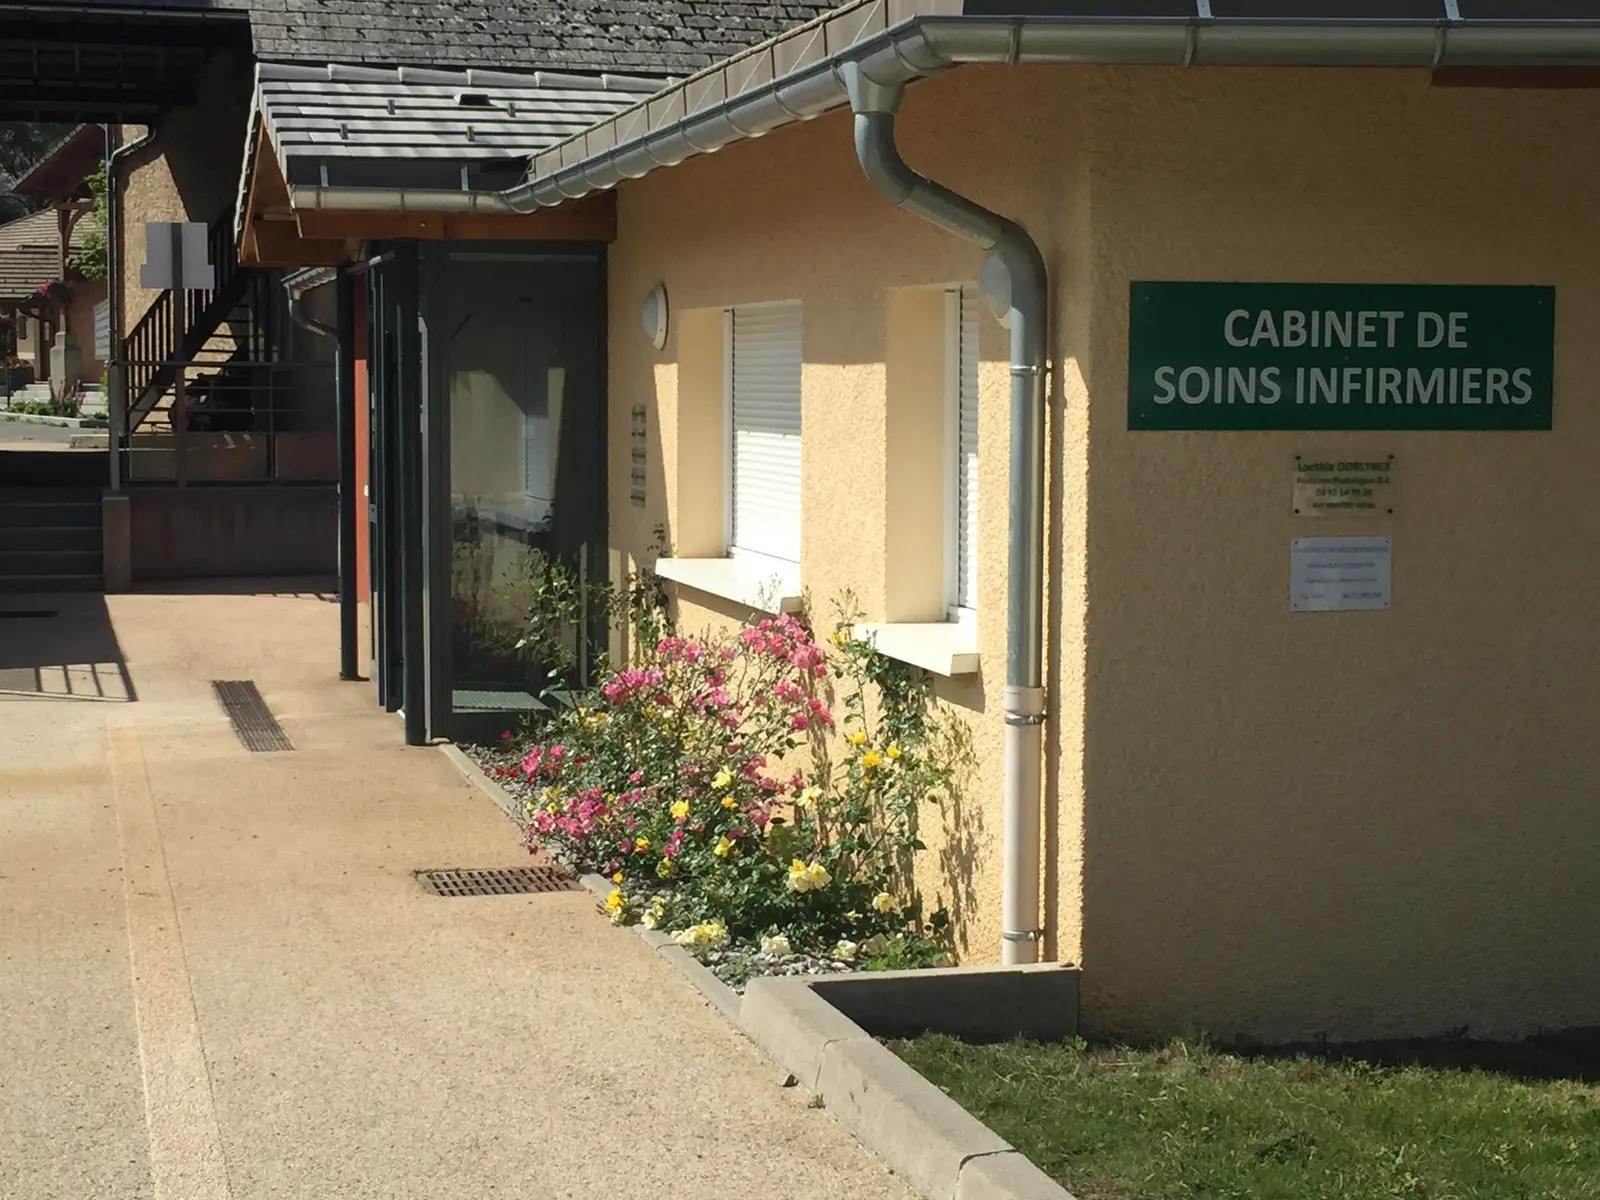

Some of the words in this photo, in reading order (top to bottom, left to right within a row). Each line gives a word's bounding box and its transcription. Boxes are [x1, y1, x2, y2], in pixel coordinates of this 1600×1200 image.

[1224, 309, 1405, 348] CABINET
[1417, 311, 1469, 348] DE
[1153, 365, 1282, 405] SOINS
[1295, 367, 1533, 405] INFIRMIERS
